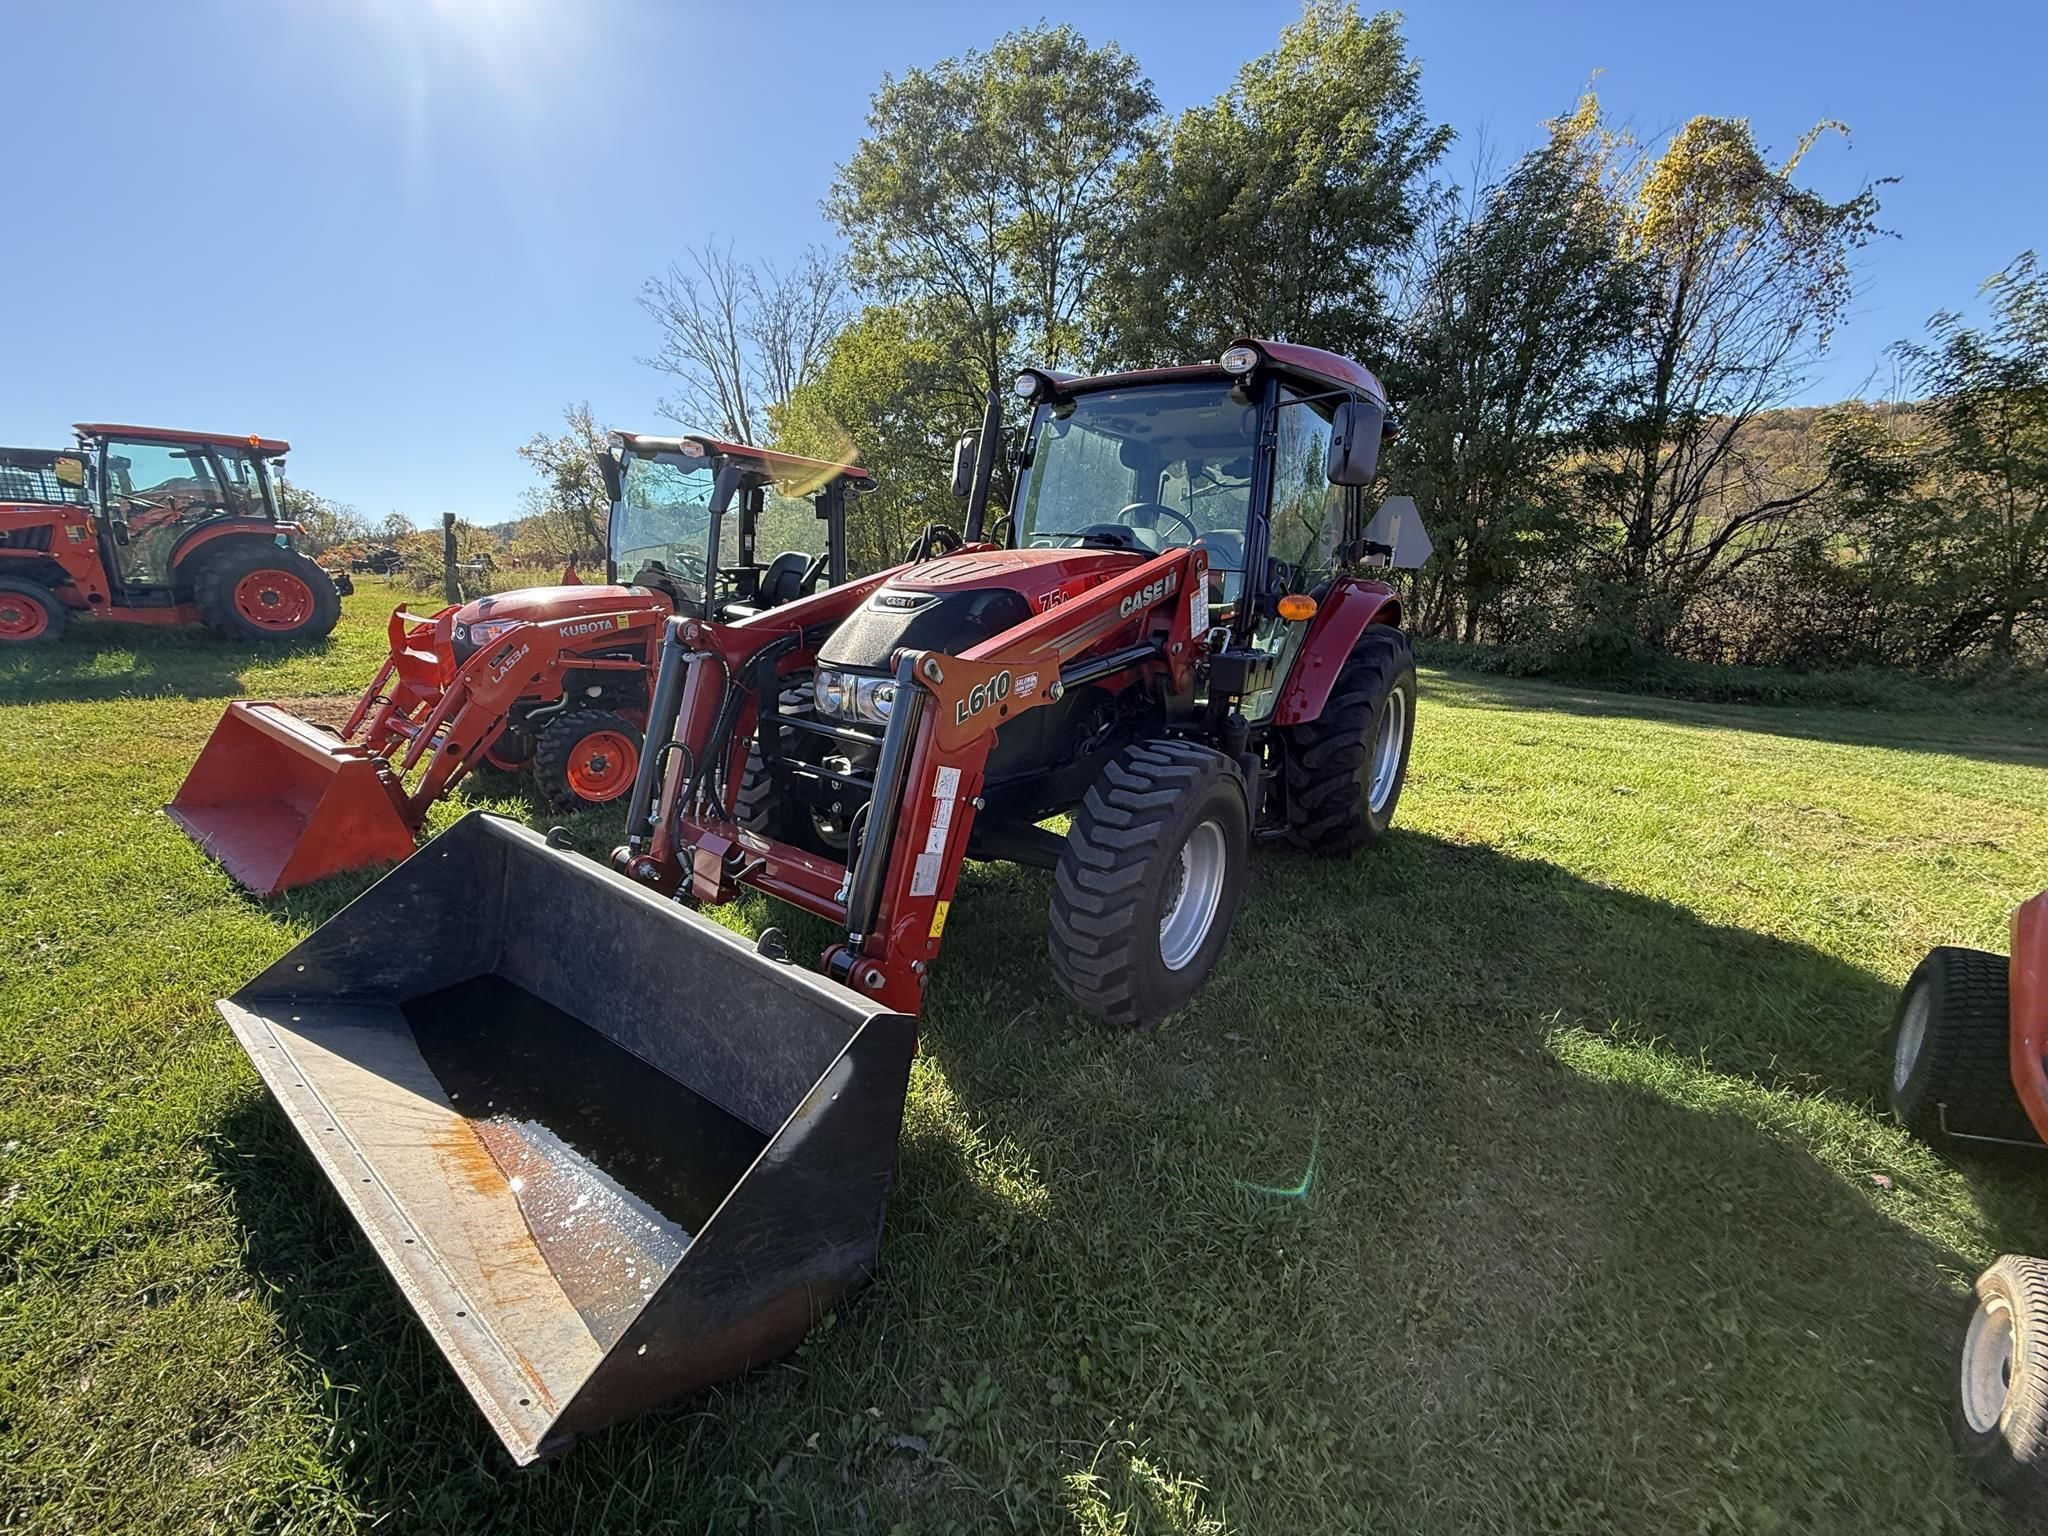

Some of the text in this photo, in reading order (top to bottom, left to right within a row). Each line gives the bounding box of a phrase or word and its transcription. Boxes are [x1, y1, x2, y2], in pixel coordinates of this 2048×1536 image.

[1120, 578, 1163, 618] CASE
[560, 620, 613, 637] KUBOTA
[491, 643, 529, 684] LA534
[956, 669, 1011, 726] L610
